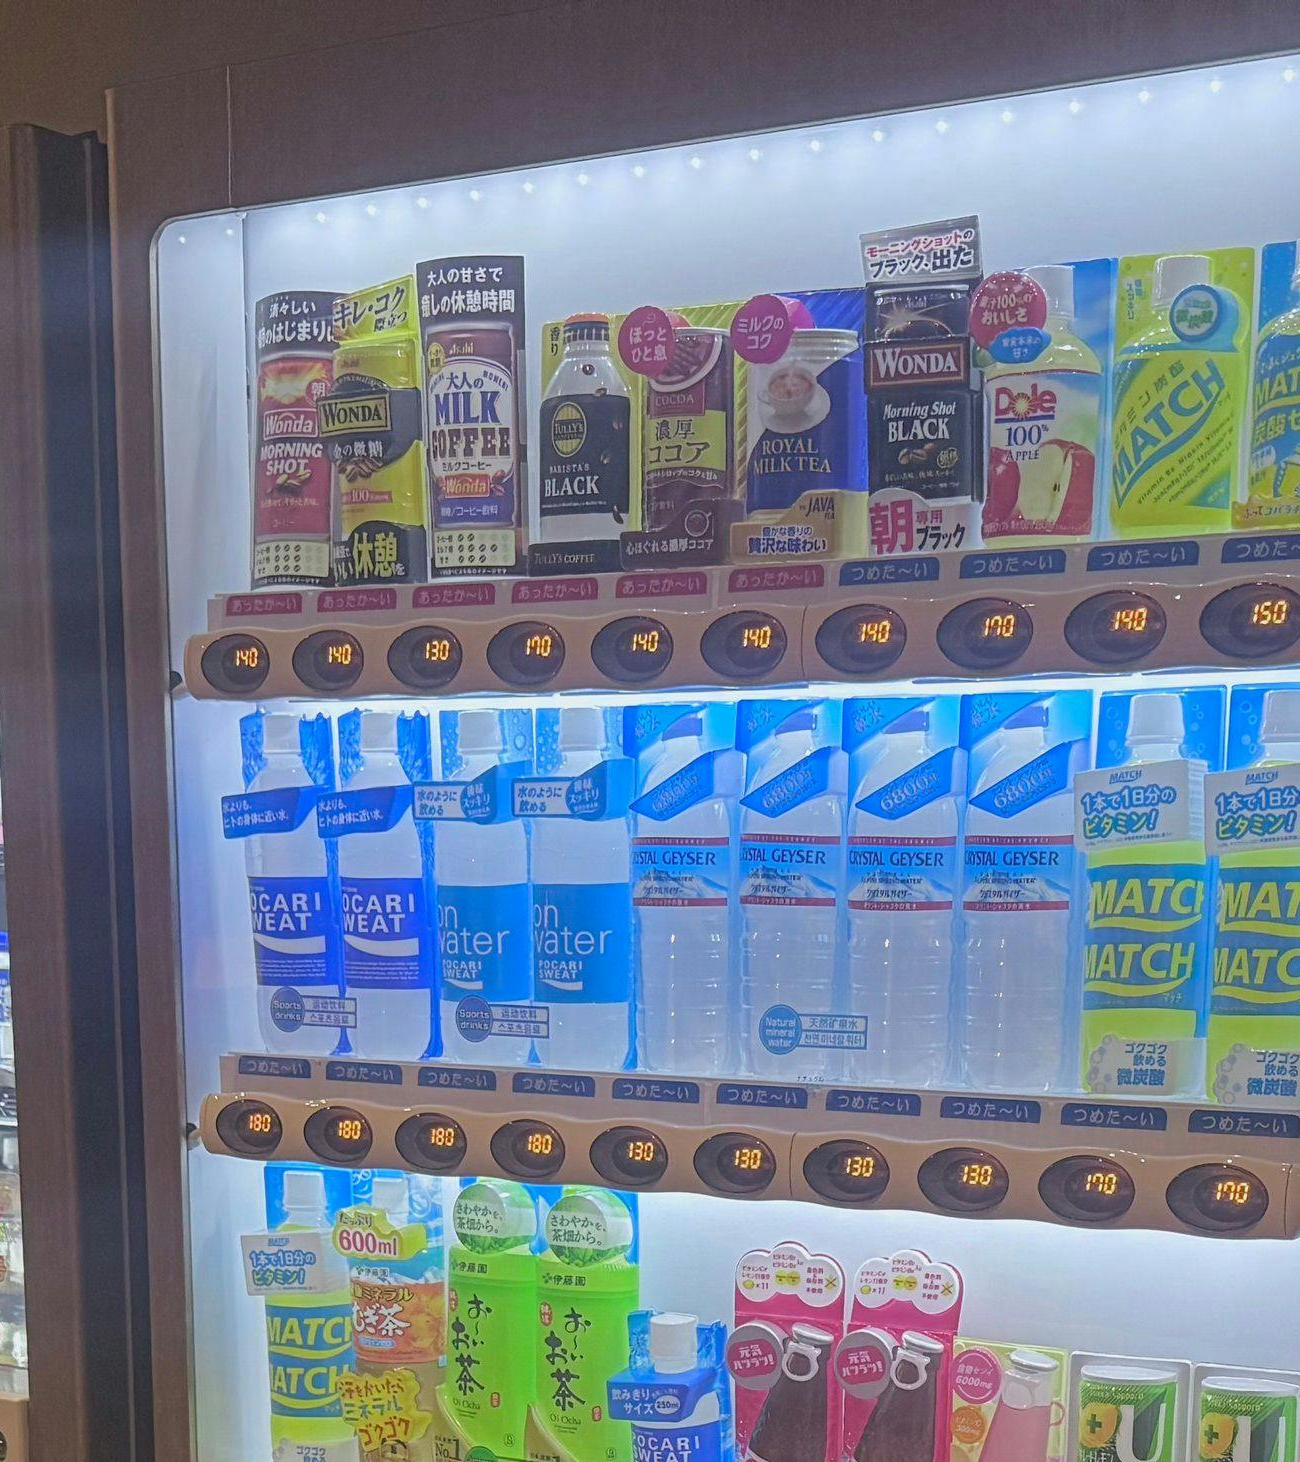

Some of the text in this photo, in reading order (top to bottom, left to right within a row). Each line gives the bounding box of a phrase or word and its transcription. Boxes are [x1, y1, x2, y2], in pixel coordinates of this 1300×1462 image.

[867, 229, 973, 258] モーニングショットの
[427, 267, 502, 287] 大人の甘さで
[738, 316, 784, 333] ミルクの
[630, 329, 666, 344] ほっと
[748, 335, 772, 350] コク
[632, 345, 667, 363] ひと息
[875, 348, 960, 379] WONDA
[446, 372, 483, 390] 大人の
[435, 391, 501, 425] MILK
[995, 383, 1057, 415] Dole
[883, 401, 956, 418] Morning Shot
[265, 415, 313, 436] Wonda
[655, 419, 694, 441] 濃厚
[888, 418, 950, 442] BLACK
[1115, 359, 1226, 483] MATCH
[432, 427, 511, 461] COFFEE
[649, 442, 709, 464] ココア
[761, 439, 818, 455] ROYAL
[1006, 449, 1040, 462] APPLE
[266, 460, 308, 476] SHOT
[442, 461, 491, 472] ミルクコーヒー
[754, 457, 831, 474] MILK TEA
[544, 476, 599, 497] BLACK
[916, 509, 942, 524] 専用
[870, 500, 914, 555] 朝
[916, 524, 965, 550] ブラック
[1253, 601, 1287, 625] 150
[425, 641, 450, 660] 130
[633, 630, 659, 652] 140
[236, 648, 258, 667] 140
[329, 645, 351, 664] 140
[518, 787, 562, 799] 水のように
[1081, 786, 1176, 814] 1本で1日分の
[1082, 808, 1159, 839] ビタミン!
[850, 851, 944, 866] CRYSTAL GEYSER
[539, 960, 583, 970] POCARI
[539, 970, 577, 980] SWEAT
[766, 1018, 795, 1027] Natural
[1124, 1043, 1168, 1054] ゴクゴク
[1117, 1069, 1166, 1087] 微炭酸
[248, 1113, 271, 1132] 180
[628, 1142, 653, 1161] 130
[845, 1158, 874, 1177] 130
[961, 1165, 992, 1185] 130
[339, 1230, 397, 1256] 600ml
[553, 1274, 586, 1286] 伊藤園
[612, 1388, 649, 1401] 飲みきり
[624, 1402, 654, 1414] サイズ
